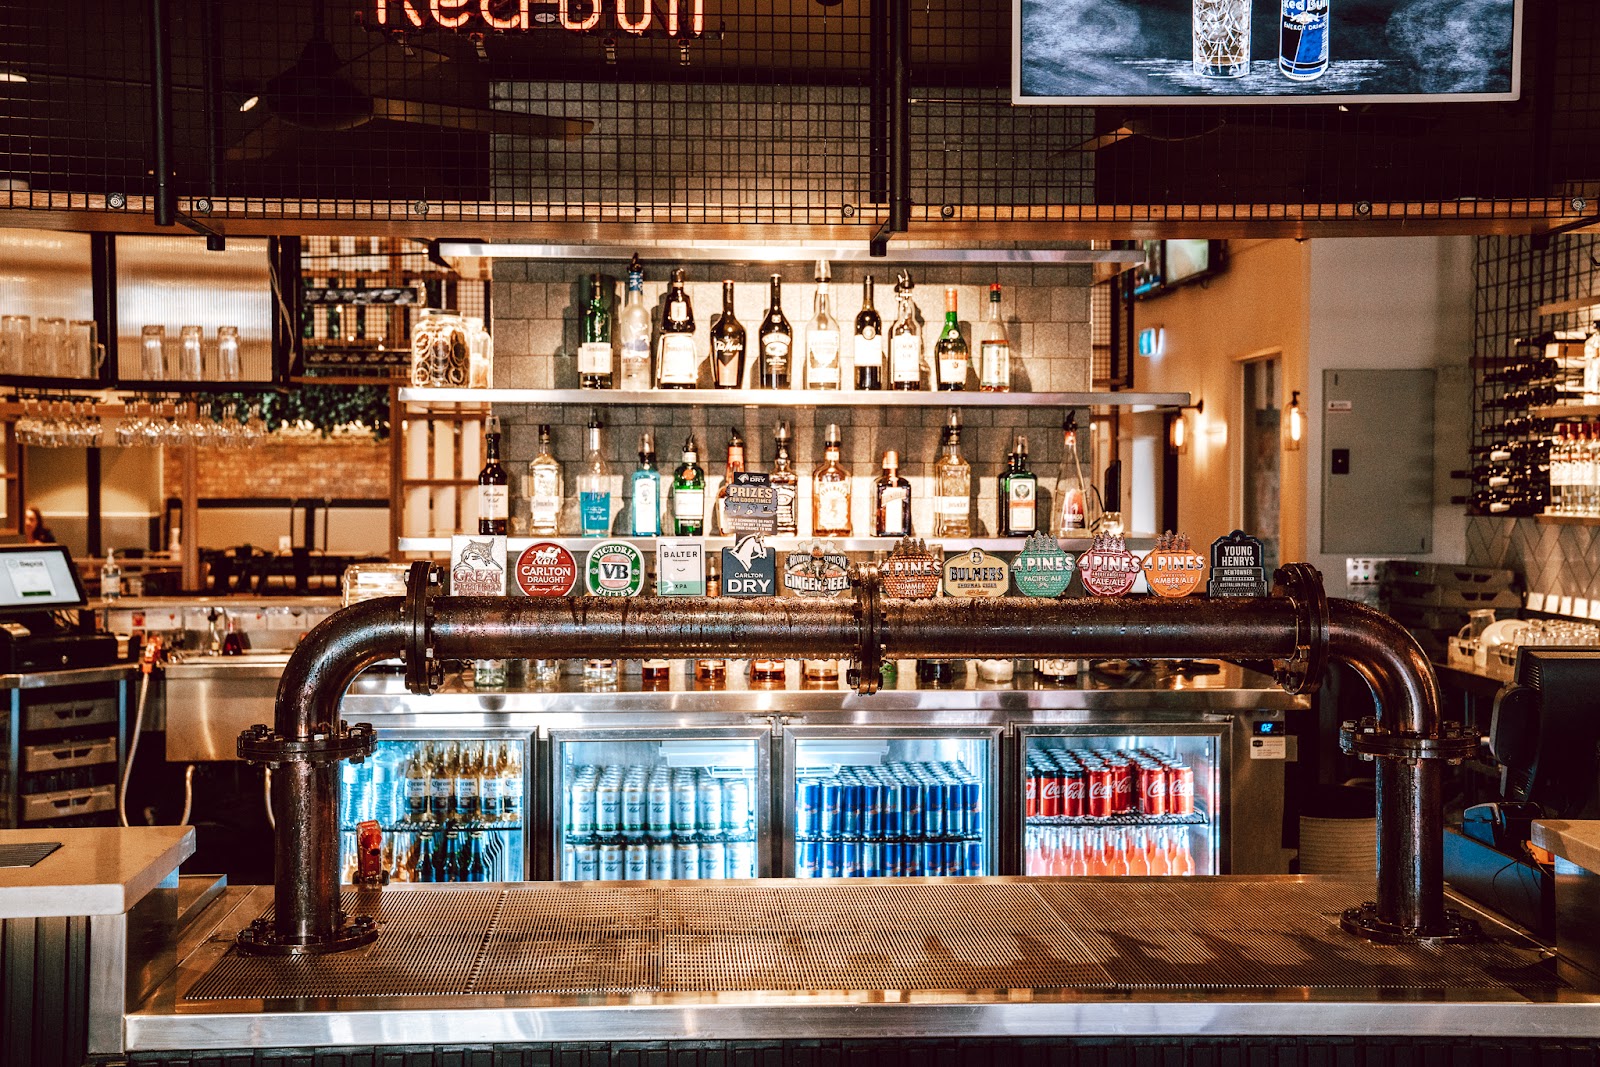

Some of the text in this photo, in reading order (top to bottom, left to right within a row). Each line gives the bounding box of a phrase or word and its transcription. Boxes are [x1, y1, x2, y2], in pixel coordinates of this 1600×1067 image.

[729, 486, 773, 499] PRIZES
[592, 545, 638, 562] VICTORIA
[1223, 545, 1253, 557] YOUNG
[823, 555, 847, 569] UNION
[1012, 556, 1075, 572] 4 PINES
[1078, 555, 1141, 573] 4 PINES
[1144, 555, 1205, 571] 4 PINES
[1221, 556, 1255, 567] HENRYS
[453, 569, 502, 583] GREAT
[521, 565, 571, 577] CARLTON
[601, 563, 629, 580] VB
[881, 561, 941, 577] 4 PINES
[949, 566, 1004, 581] BULMERS
[727, 579, 771, 593] DRY
[784, 573, 822, 591] GINGER
[1091, 577, 1126, 586] PALE ALE
[1154, 576, 1180, 584] AMBER
[595, 586, 635, 597] BITTER
